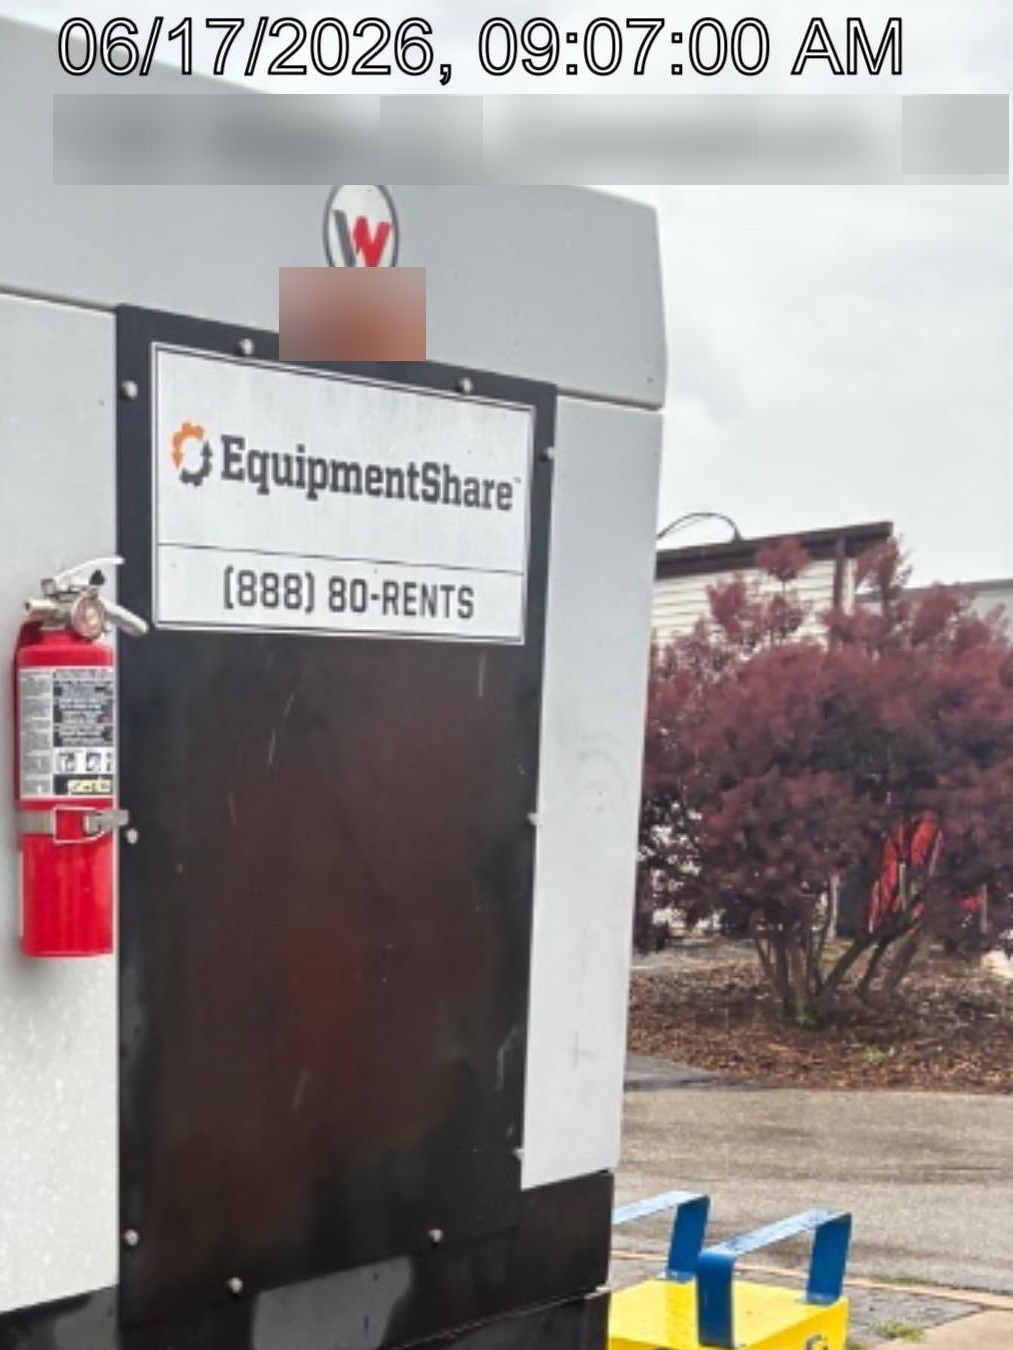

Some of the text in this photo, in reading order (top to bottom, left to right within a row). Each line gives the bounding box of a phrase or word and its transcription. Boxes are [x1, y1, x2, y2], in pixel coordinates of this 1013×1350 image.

[221, 434, 514, 512] EquipmentShare
[223, 564, 476, 620] (888) 80-RENTS
